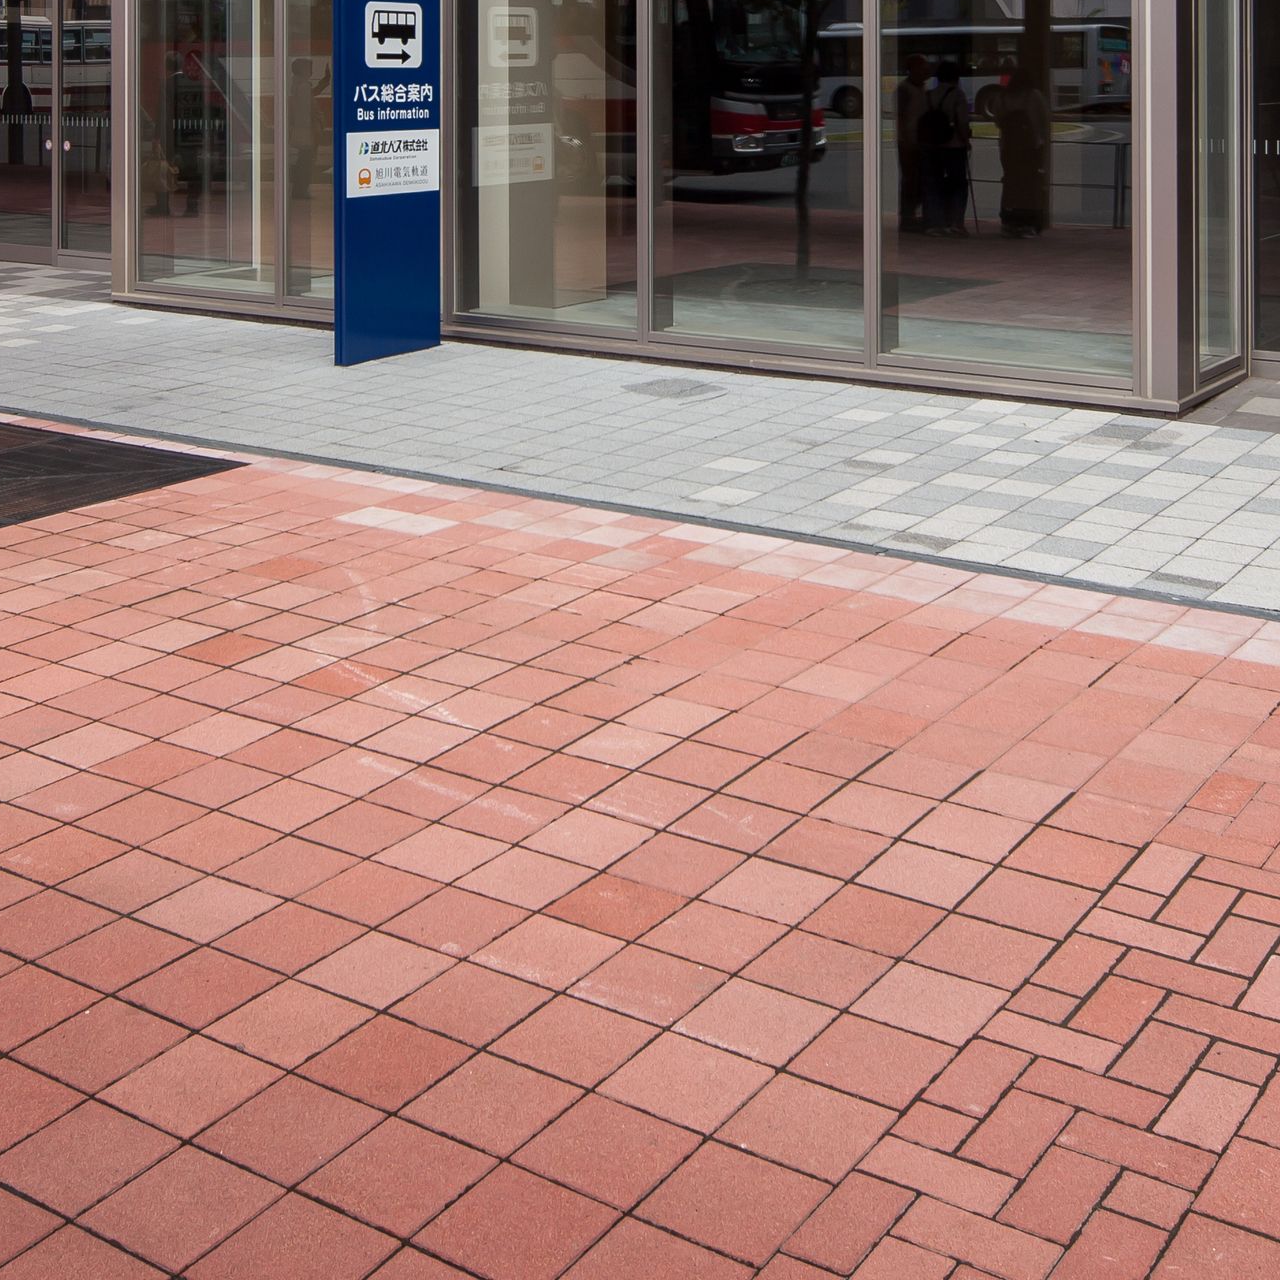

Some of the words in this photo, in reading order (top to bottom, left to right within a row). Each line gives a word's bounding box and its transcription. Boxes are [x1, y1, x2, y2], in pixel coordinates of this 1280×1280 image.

[353, 83, 433, 102] バス総合案内
[357, 108, 374, 121] Bus
[377, 106, 430, 120] information
[370, 138, 429, 155] 道北バス株式会社
[375, 164, 428, 180] 旭川電気軌道
